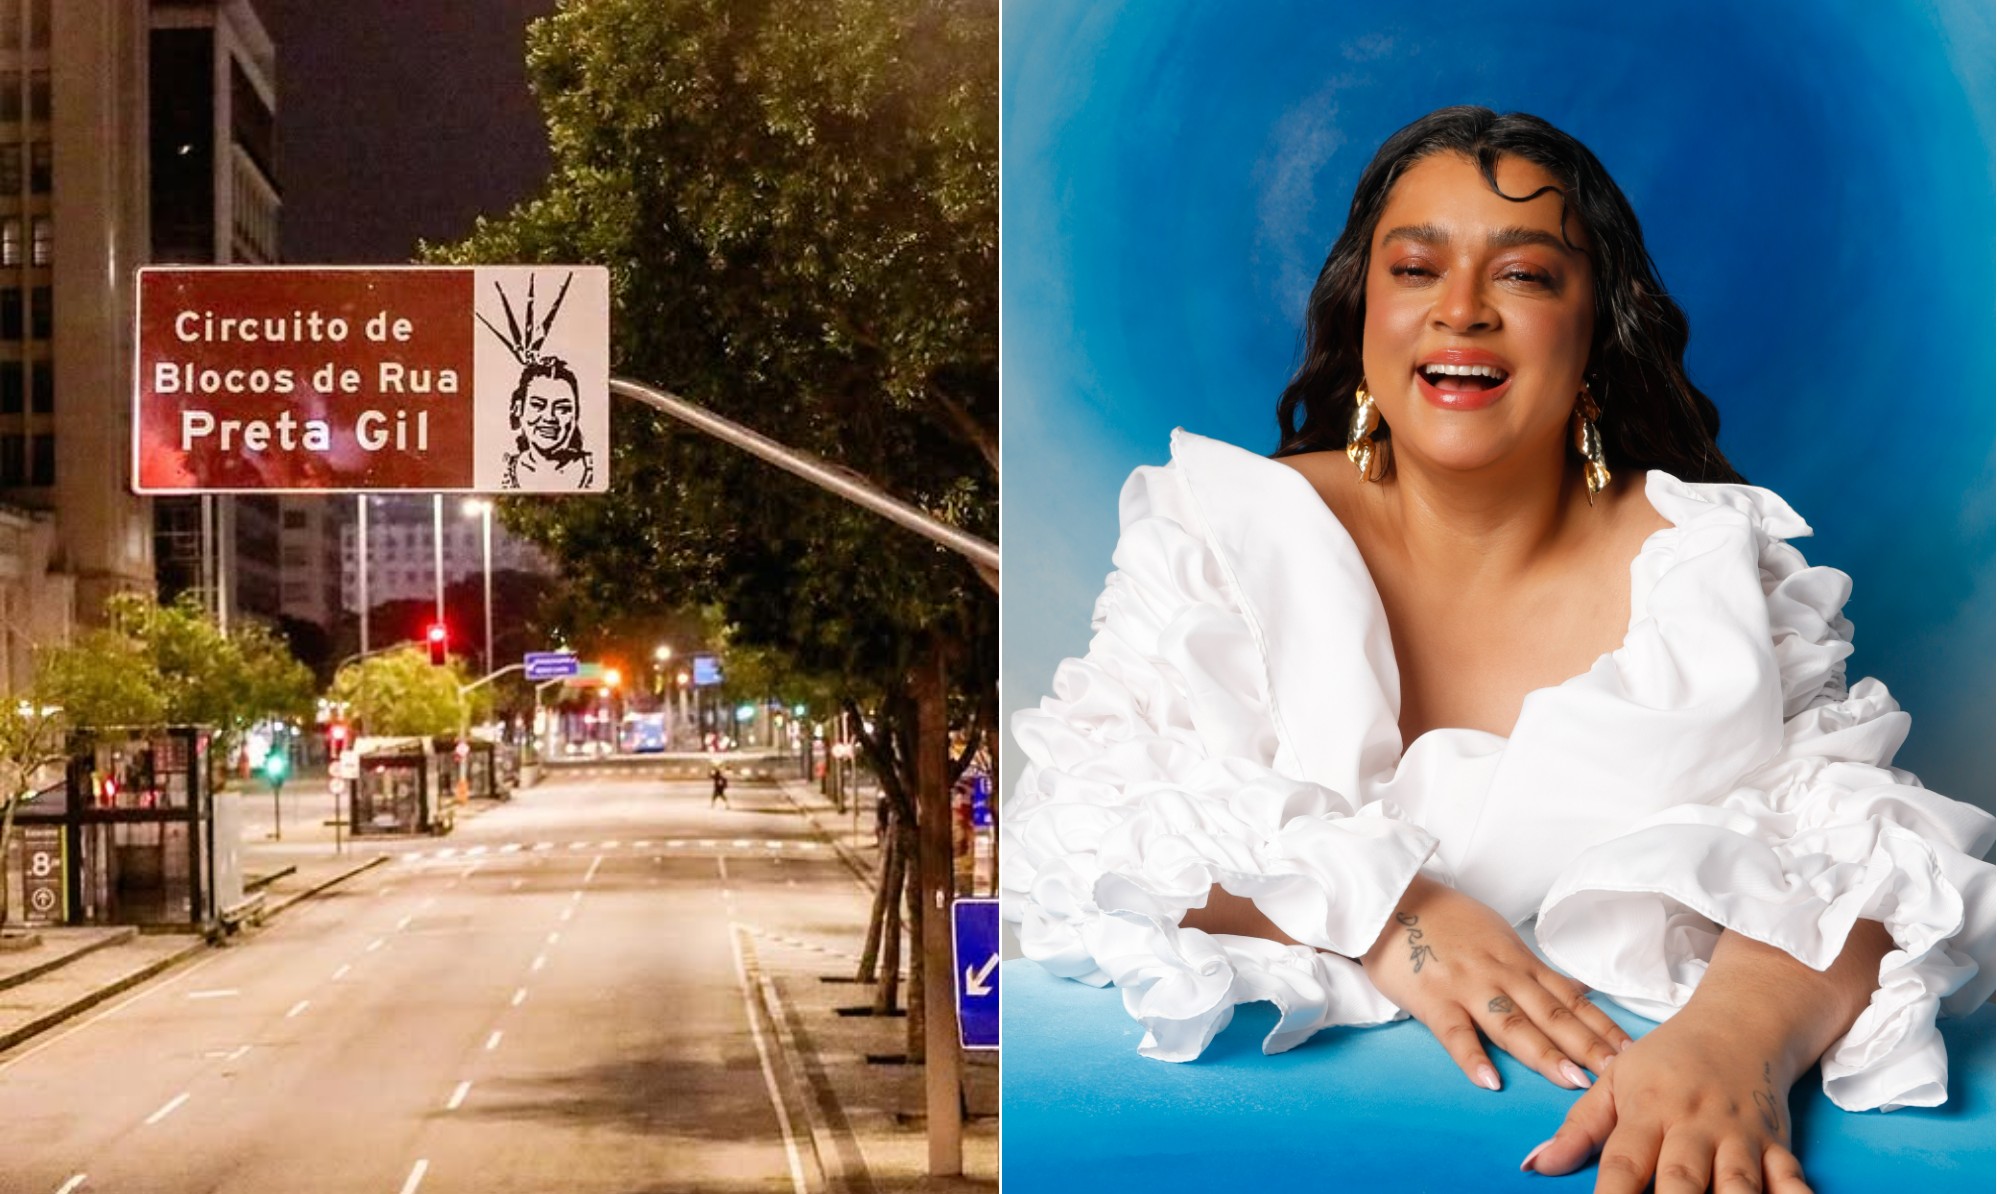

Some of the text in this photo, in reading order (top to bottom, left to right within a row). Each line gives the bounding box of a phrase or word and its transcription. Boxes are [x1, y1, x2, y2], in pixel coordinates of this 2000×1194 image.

[175, 310, 413, 342] Circuito de
[154, 362, 458, 394] Blocos de Rua
[182, 410, 428, 451] Preta Gil
